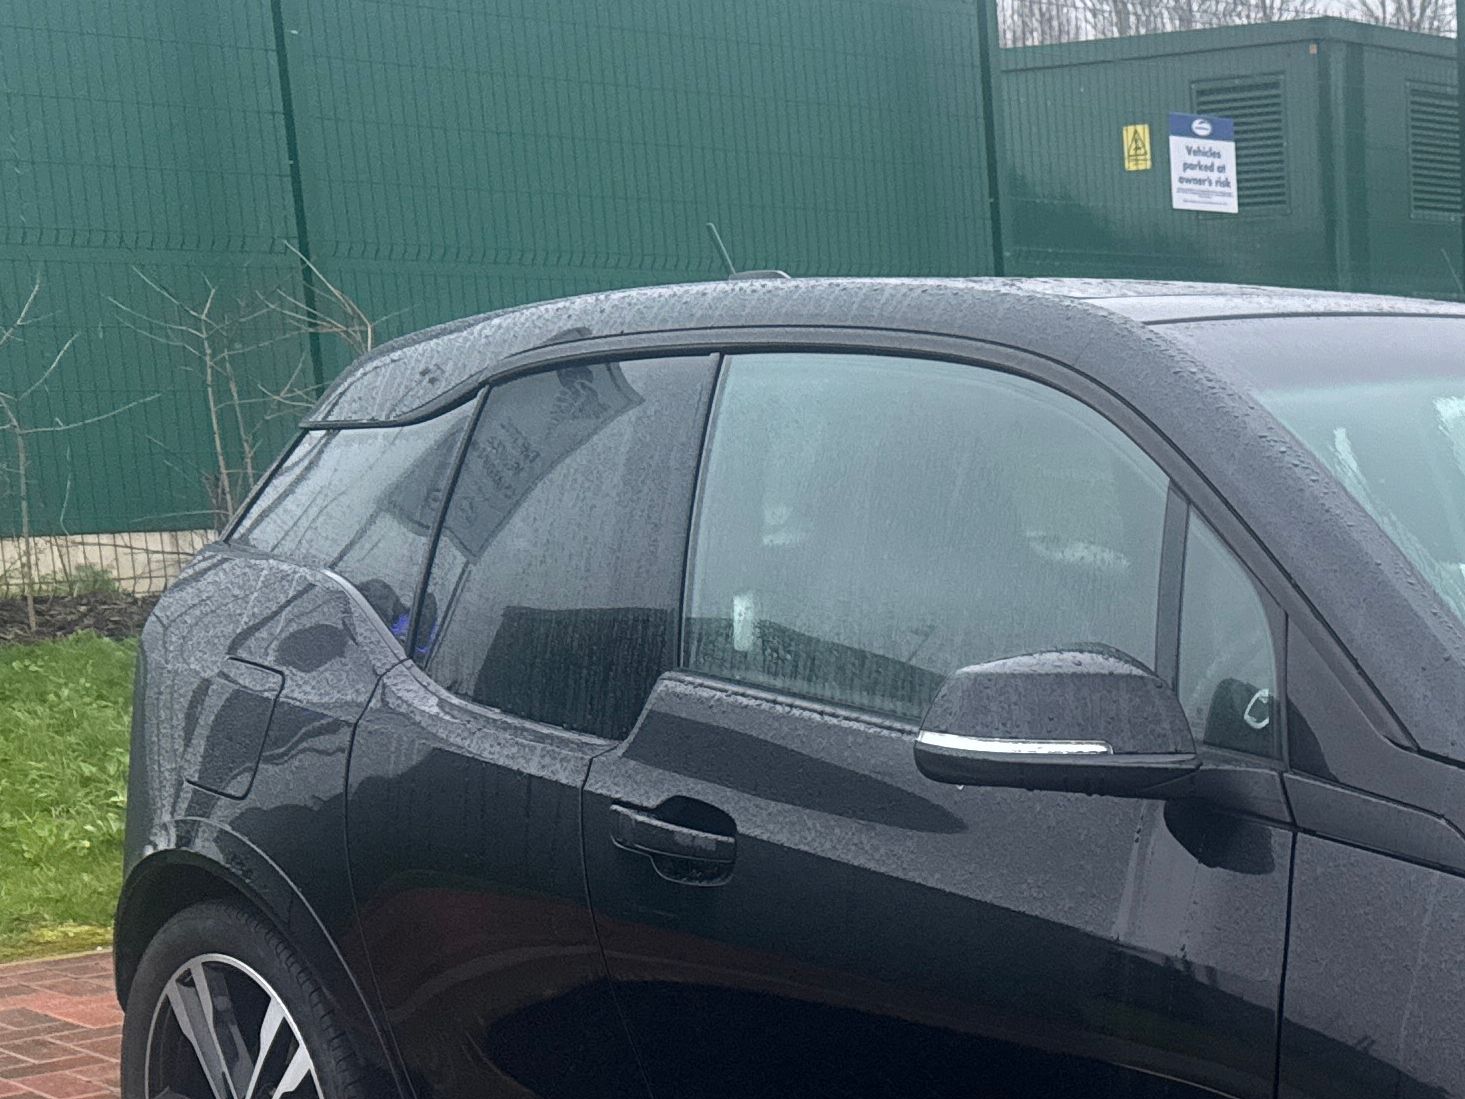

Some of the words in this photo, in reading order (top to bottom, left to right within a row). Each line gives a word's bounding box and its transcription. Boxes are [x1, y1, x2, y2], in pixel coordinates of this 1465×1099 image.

[1185, 145, 1222, 159] Vehicles
[1182, 161, 1215, 173] parked
[1217, 164, 1226, 173] at
[1178, 176, 1213, 188] owner's
[1214, 177, 1232, 188] risk
